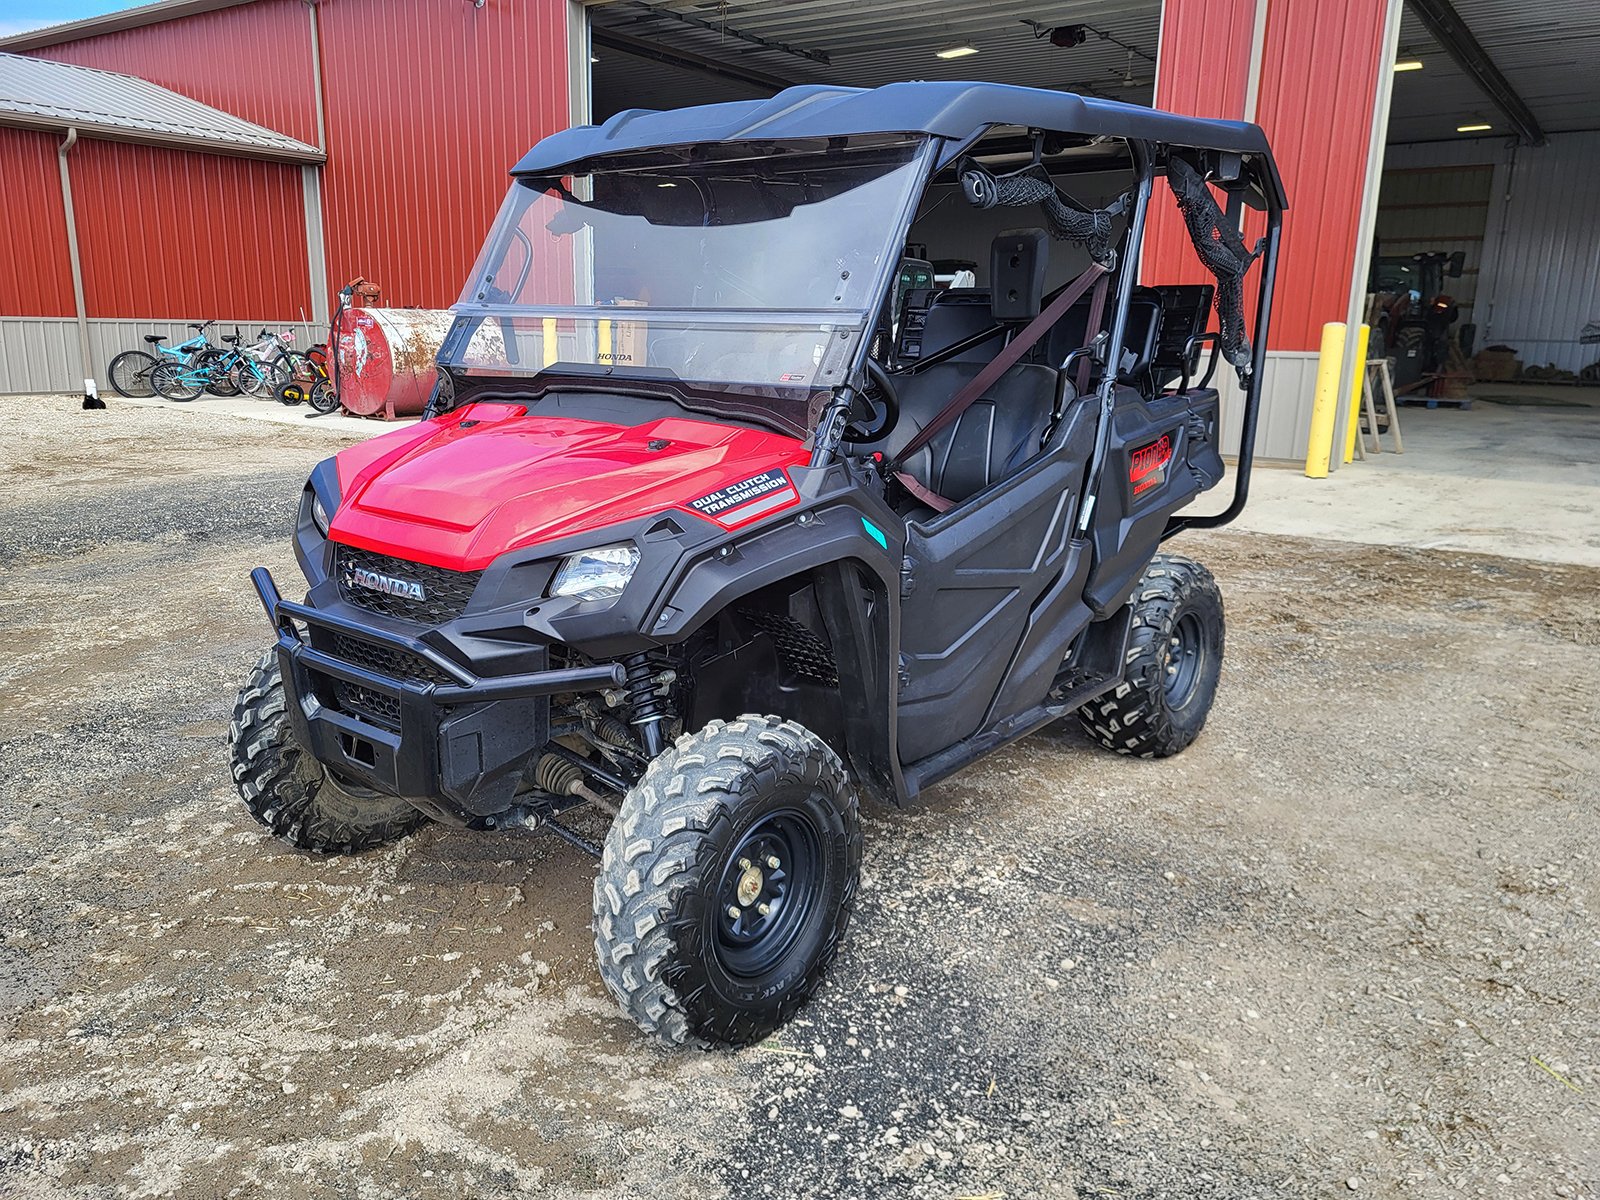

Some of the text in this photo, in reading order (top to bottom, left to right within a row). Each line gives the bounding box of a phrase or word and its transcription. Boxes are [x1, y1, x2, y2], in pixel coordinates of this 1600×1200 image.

[597, 353, 632, 361] HONDA
[692, 473, 771, 509] DUAL CLUTCH
[702, 476, 787, 514] TRANSMISSION
[353, 568, 426, 601] HONDA
